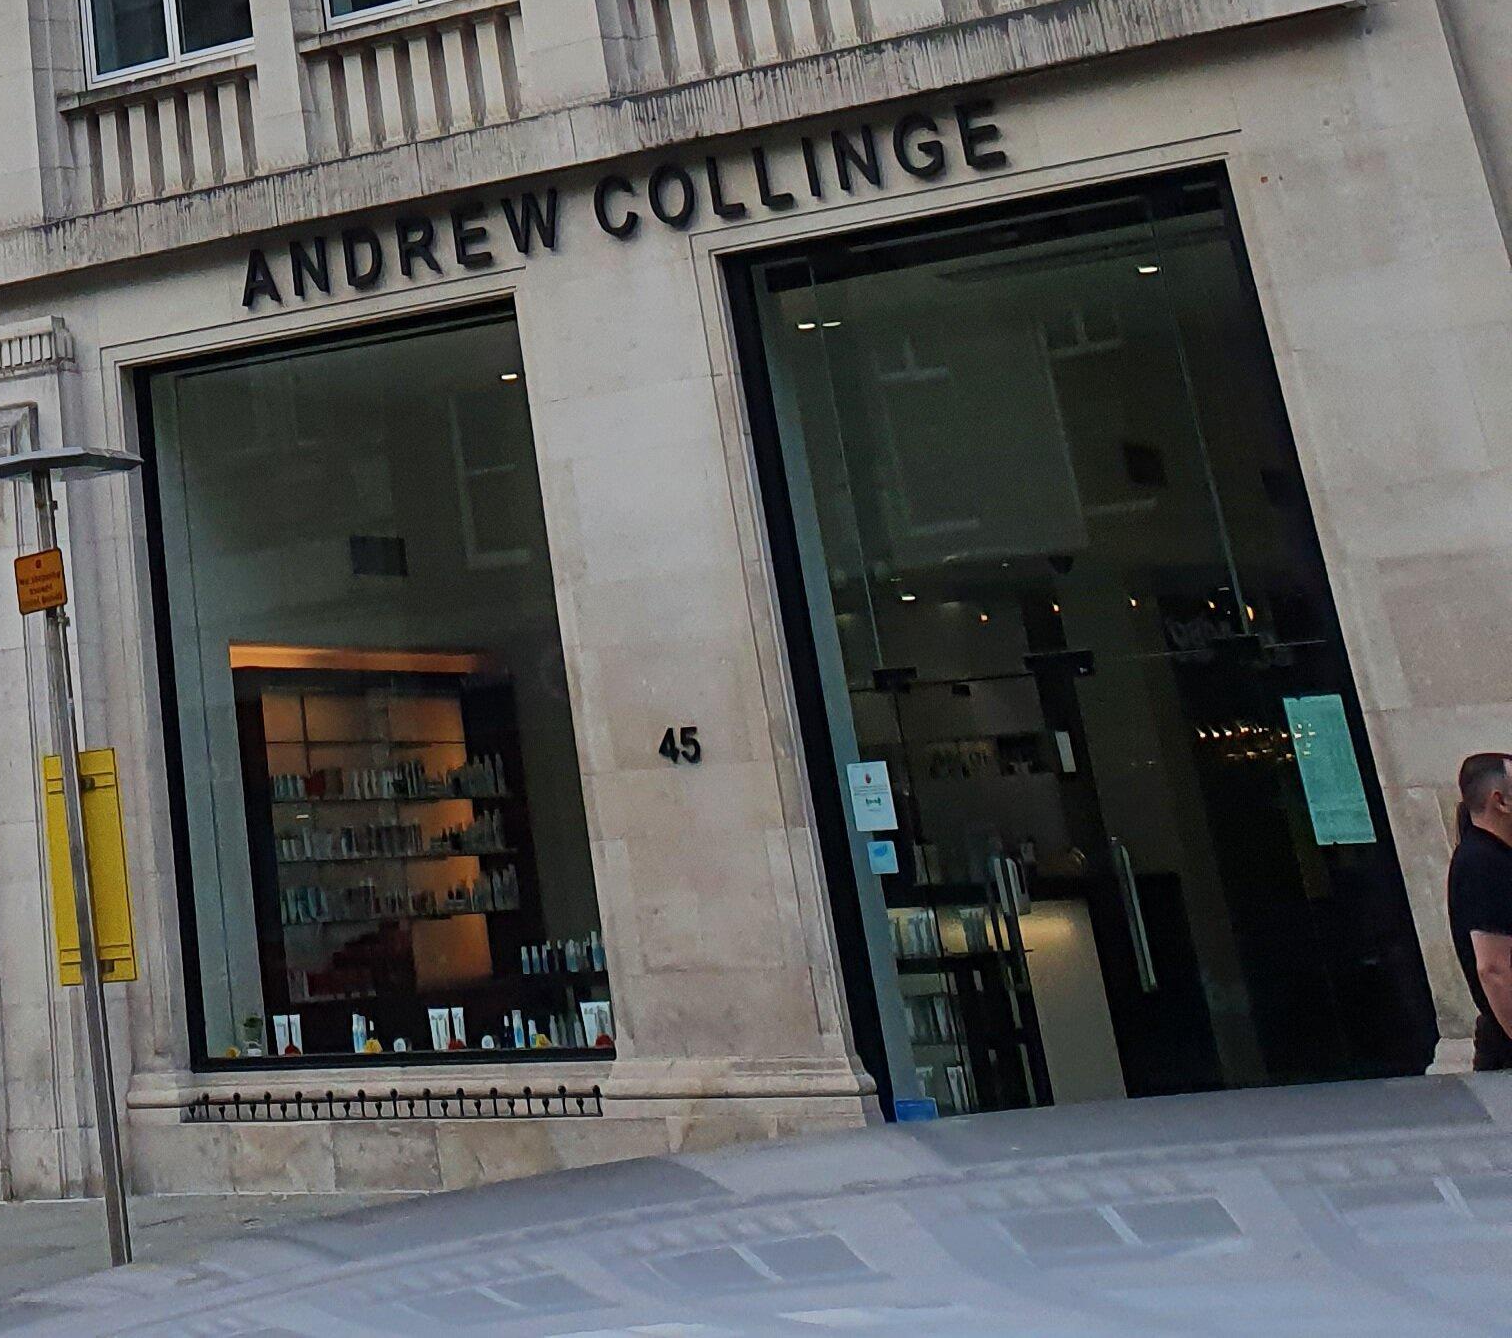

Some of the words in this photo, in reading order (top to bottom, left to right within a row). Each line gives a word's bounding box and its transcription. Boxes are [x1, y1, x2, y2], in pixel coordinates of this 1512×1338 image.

[241, 186, 559, 311] ANDREW
[592, 100, 1009, 241] COLLINGE
[658, 725, 702, 764] 45
